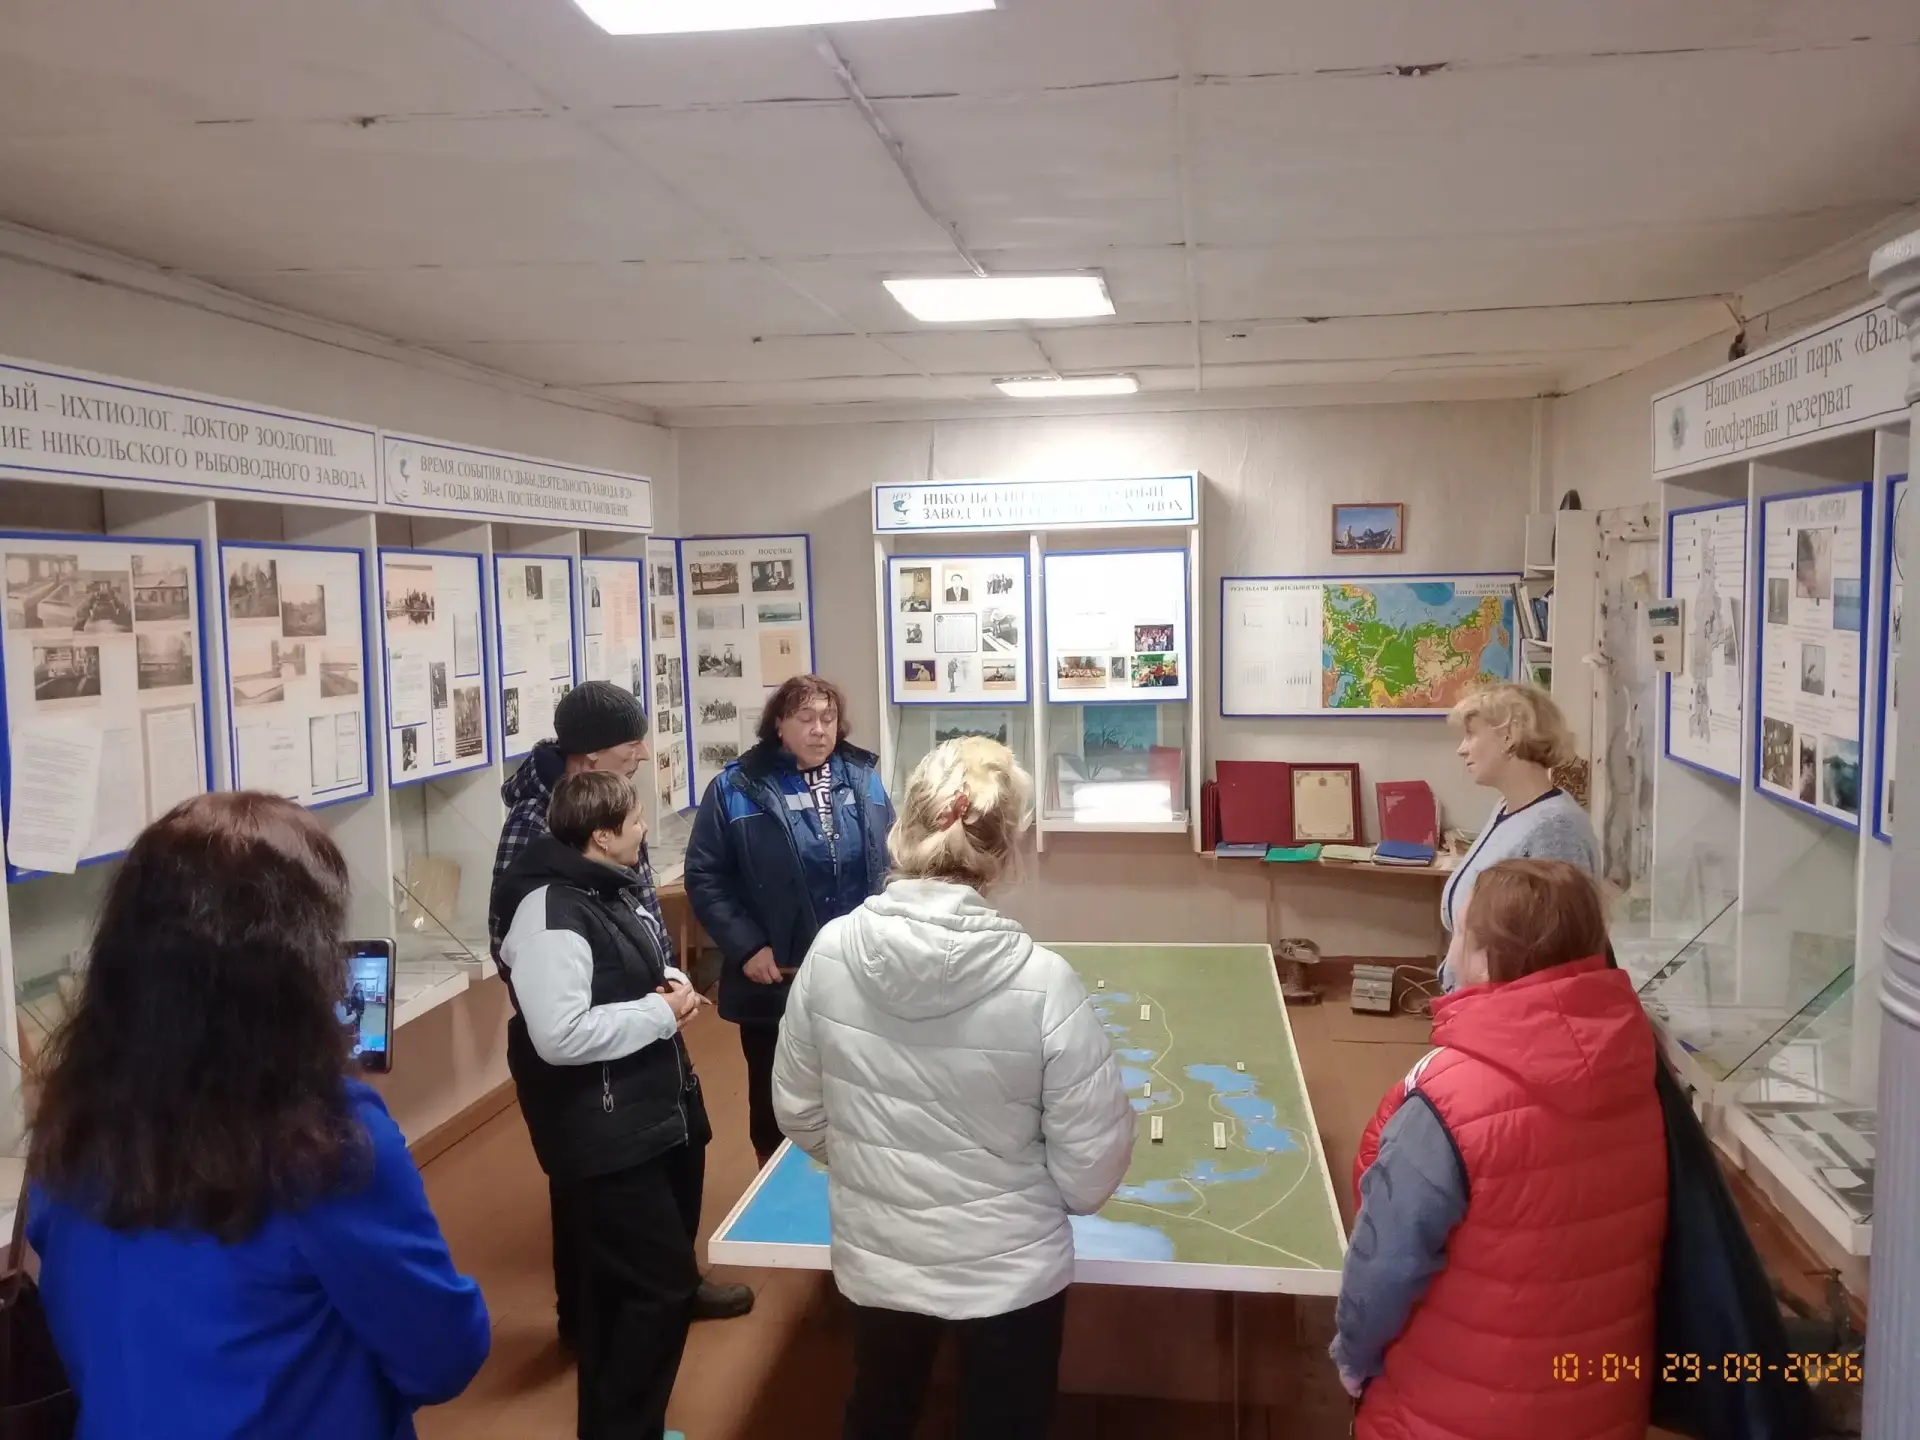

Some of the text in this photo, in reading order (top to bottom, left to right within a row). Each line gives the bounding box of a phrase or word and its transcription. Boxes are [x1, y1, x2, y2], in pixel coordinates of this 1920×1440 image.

[1704, 347, 1798, 411] Национальный
[1805, 337, 1844, 377] парк
[182, 414, 249, 443] ДОКТОР
[1787, 383, 1854, 436] резерват
[42, 430, 188, 468] НИКОЛЬСКОГО
[195, 450, 310, 482] РЫБОВОДНОГО
[315, 466, 367, 489] ЗАВОДА
